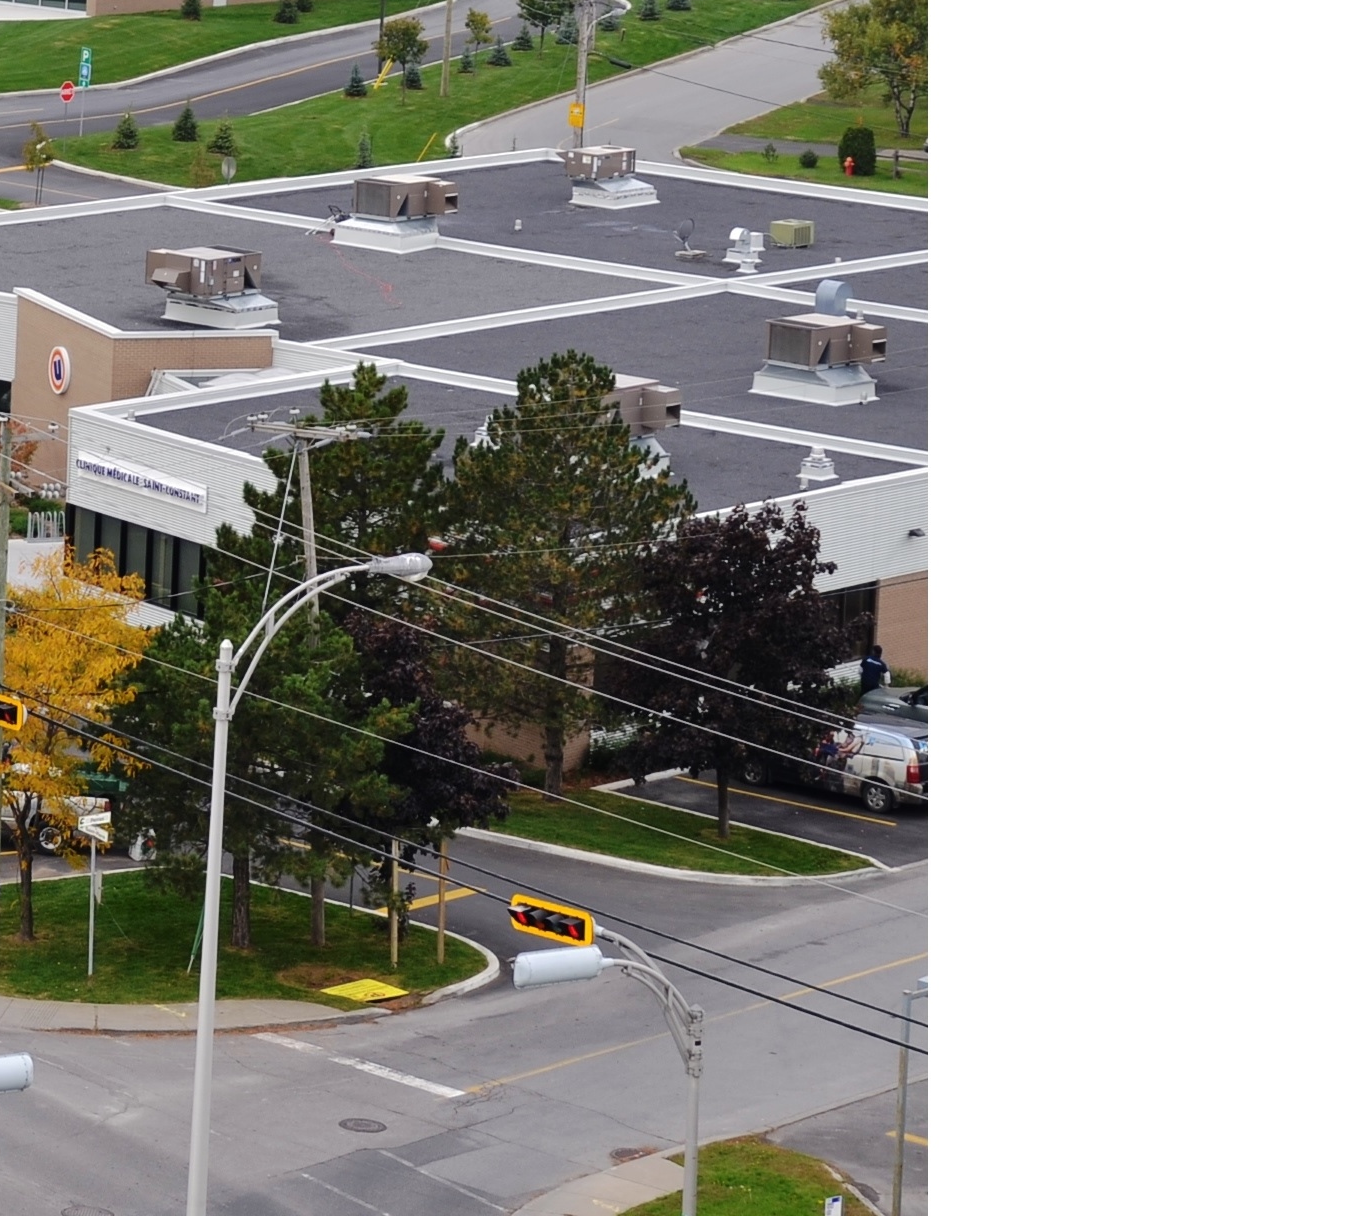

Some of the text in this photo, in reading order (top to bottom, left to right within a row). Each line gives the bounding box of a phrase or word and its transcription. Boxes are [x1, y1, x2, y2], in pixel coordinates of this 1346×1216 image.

[82, 49, 90, 62] P
[75, 458, 201, 504] CLINIQUE MÉDICALE SAINT-CONSTANT
